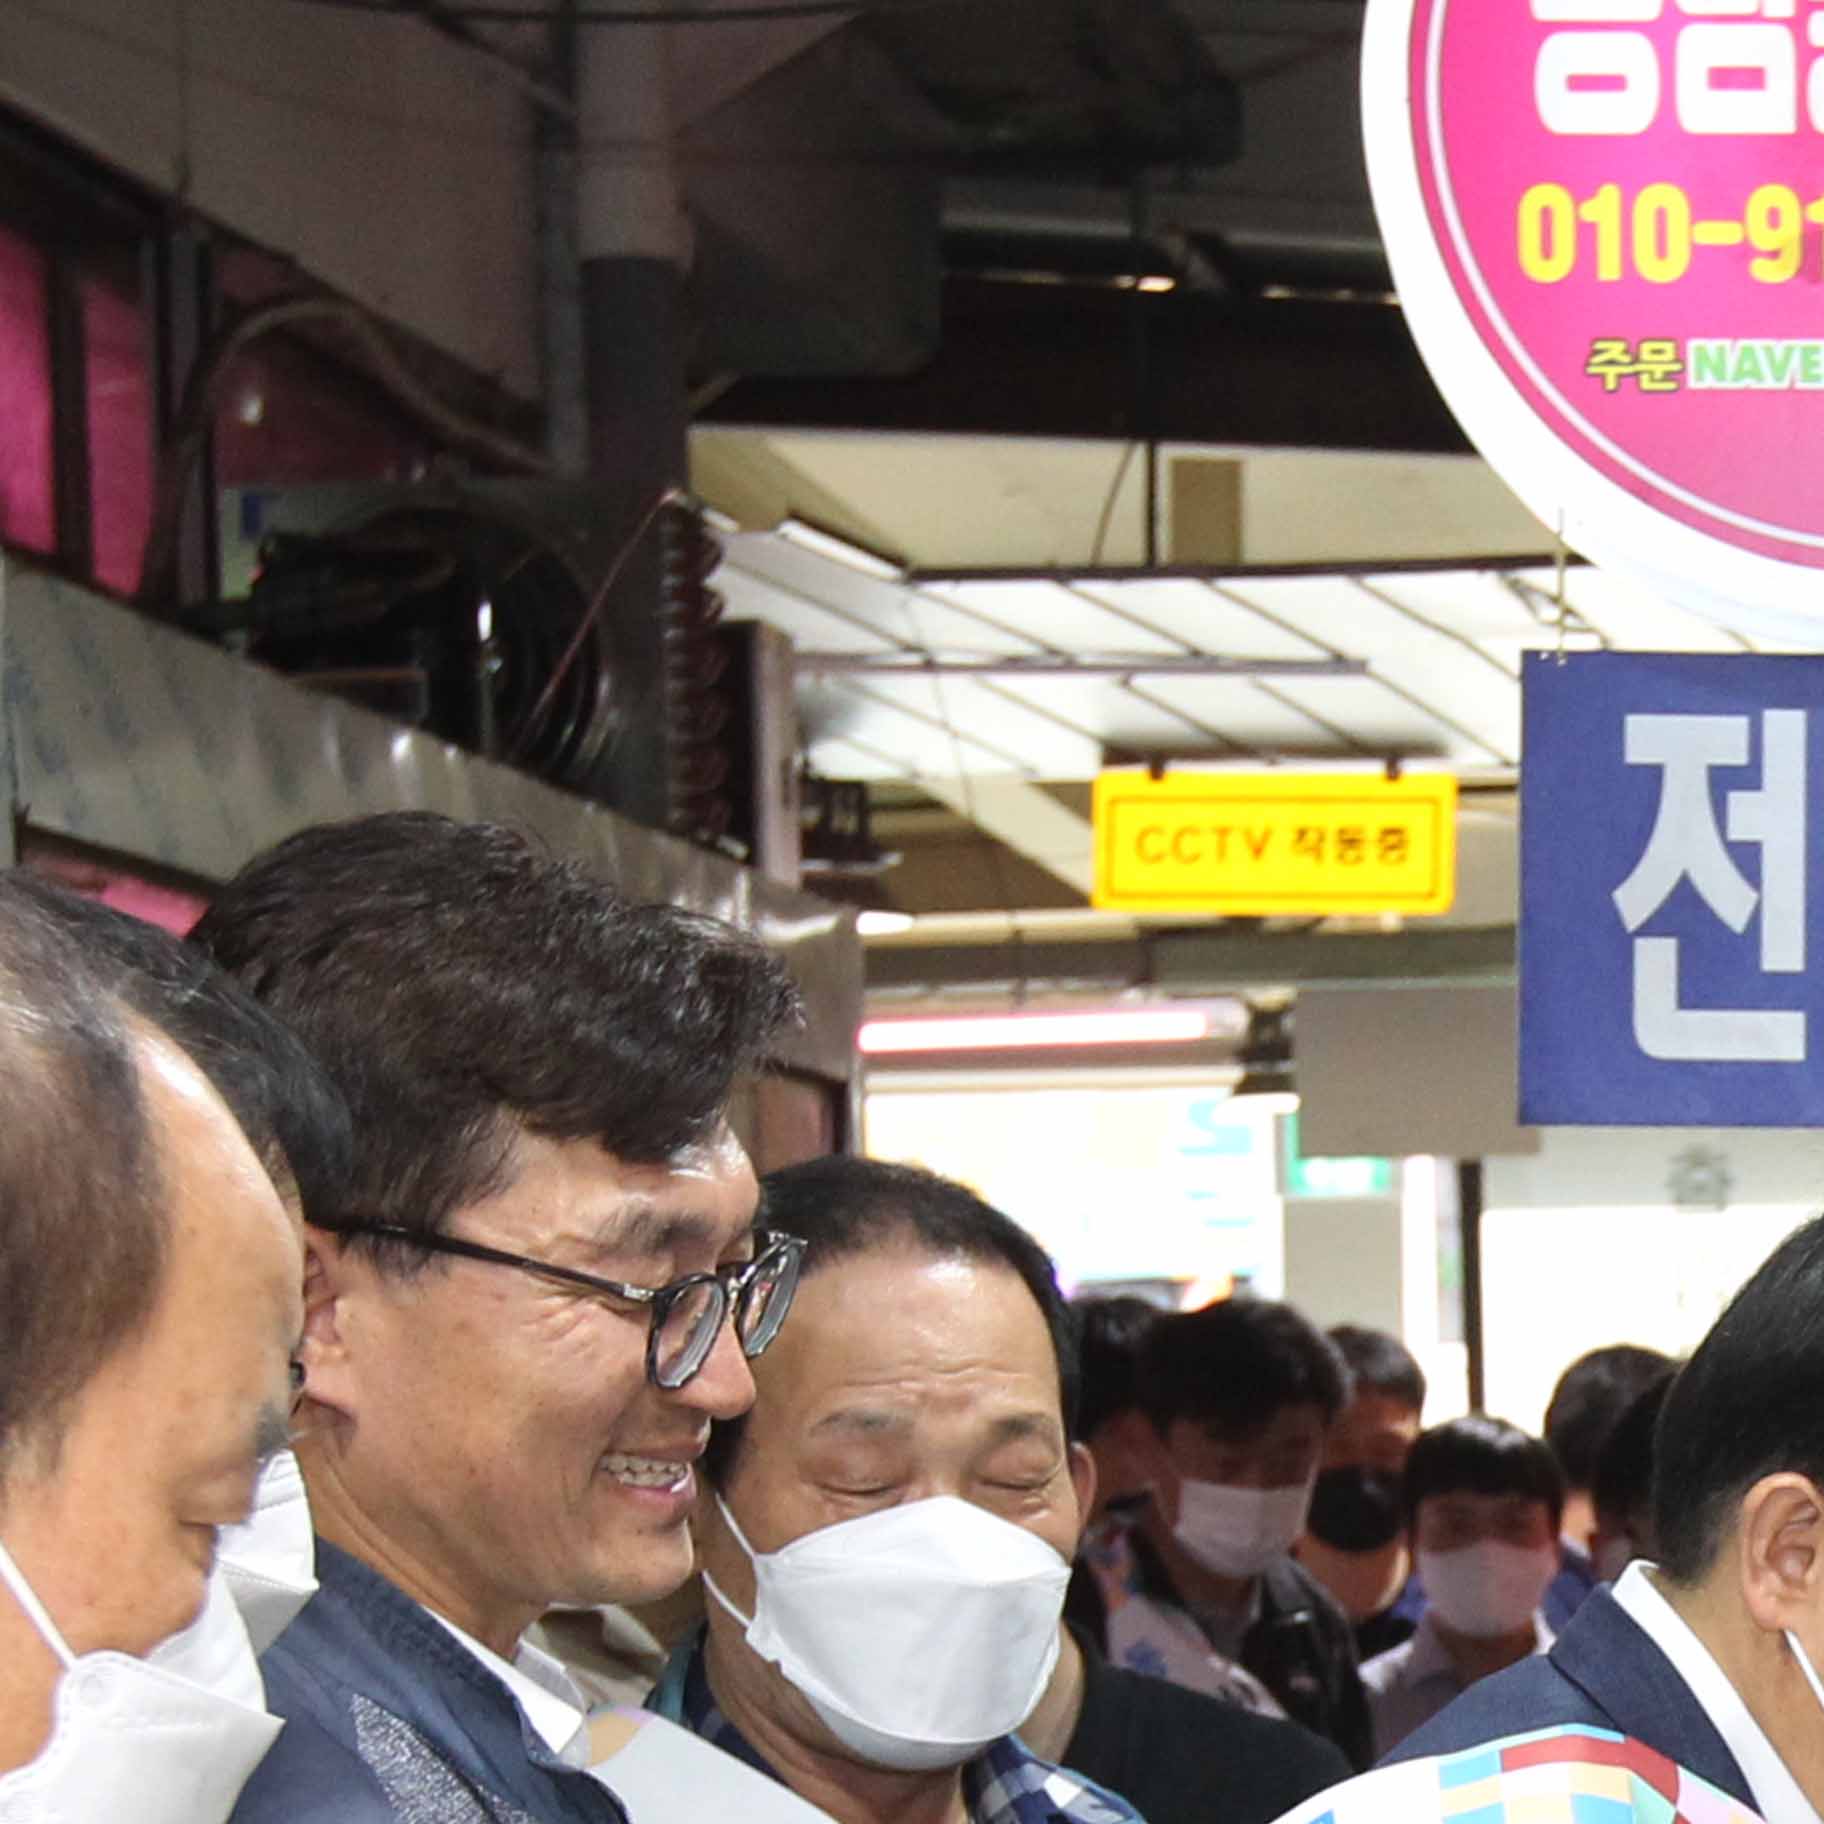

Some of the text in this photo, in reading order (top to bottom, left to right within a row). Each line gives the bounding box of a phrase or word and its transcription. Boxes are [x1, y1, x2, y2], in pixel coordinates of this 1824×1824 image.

[1585, 337, 1683, 393] 주문
[1134, 825, 1410, 867] CCTV 작동중
